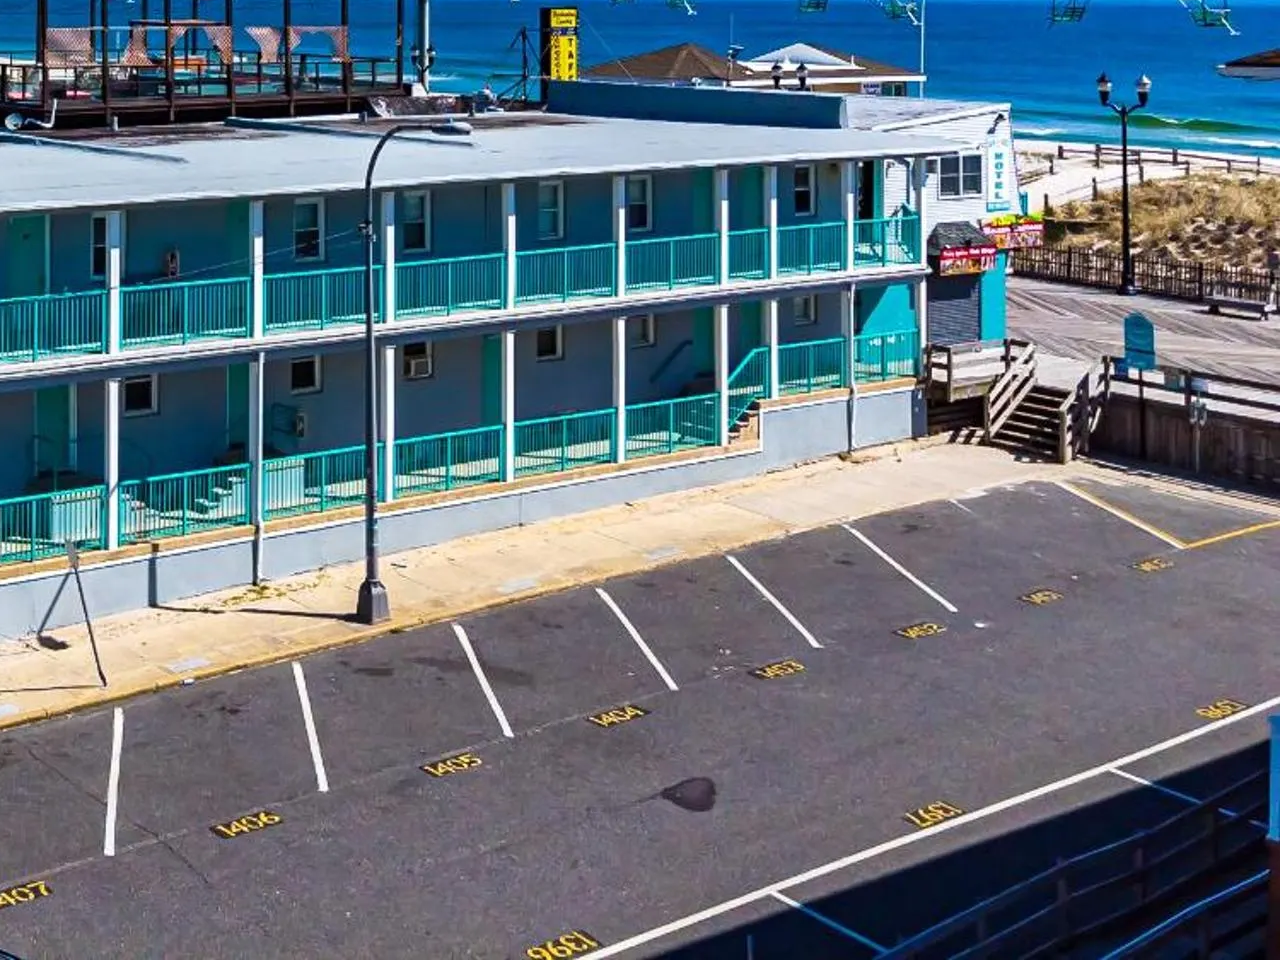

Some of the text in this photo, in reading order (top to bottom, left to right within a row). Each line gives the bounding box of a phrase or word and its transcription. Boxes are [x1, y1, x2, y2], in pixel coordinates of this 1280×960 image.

[994, 152, 1004, 200] MOTEL
[588, 706, 646, 727] 1404
[423, 753, 483, 777] 1405
[215, 811, 281, 837] 1406
[904, 801, 963, 828] 1397
